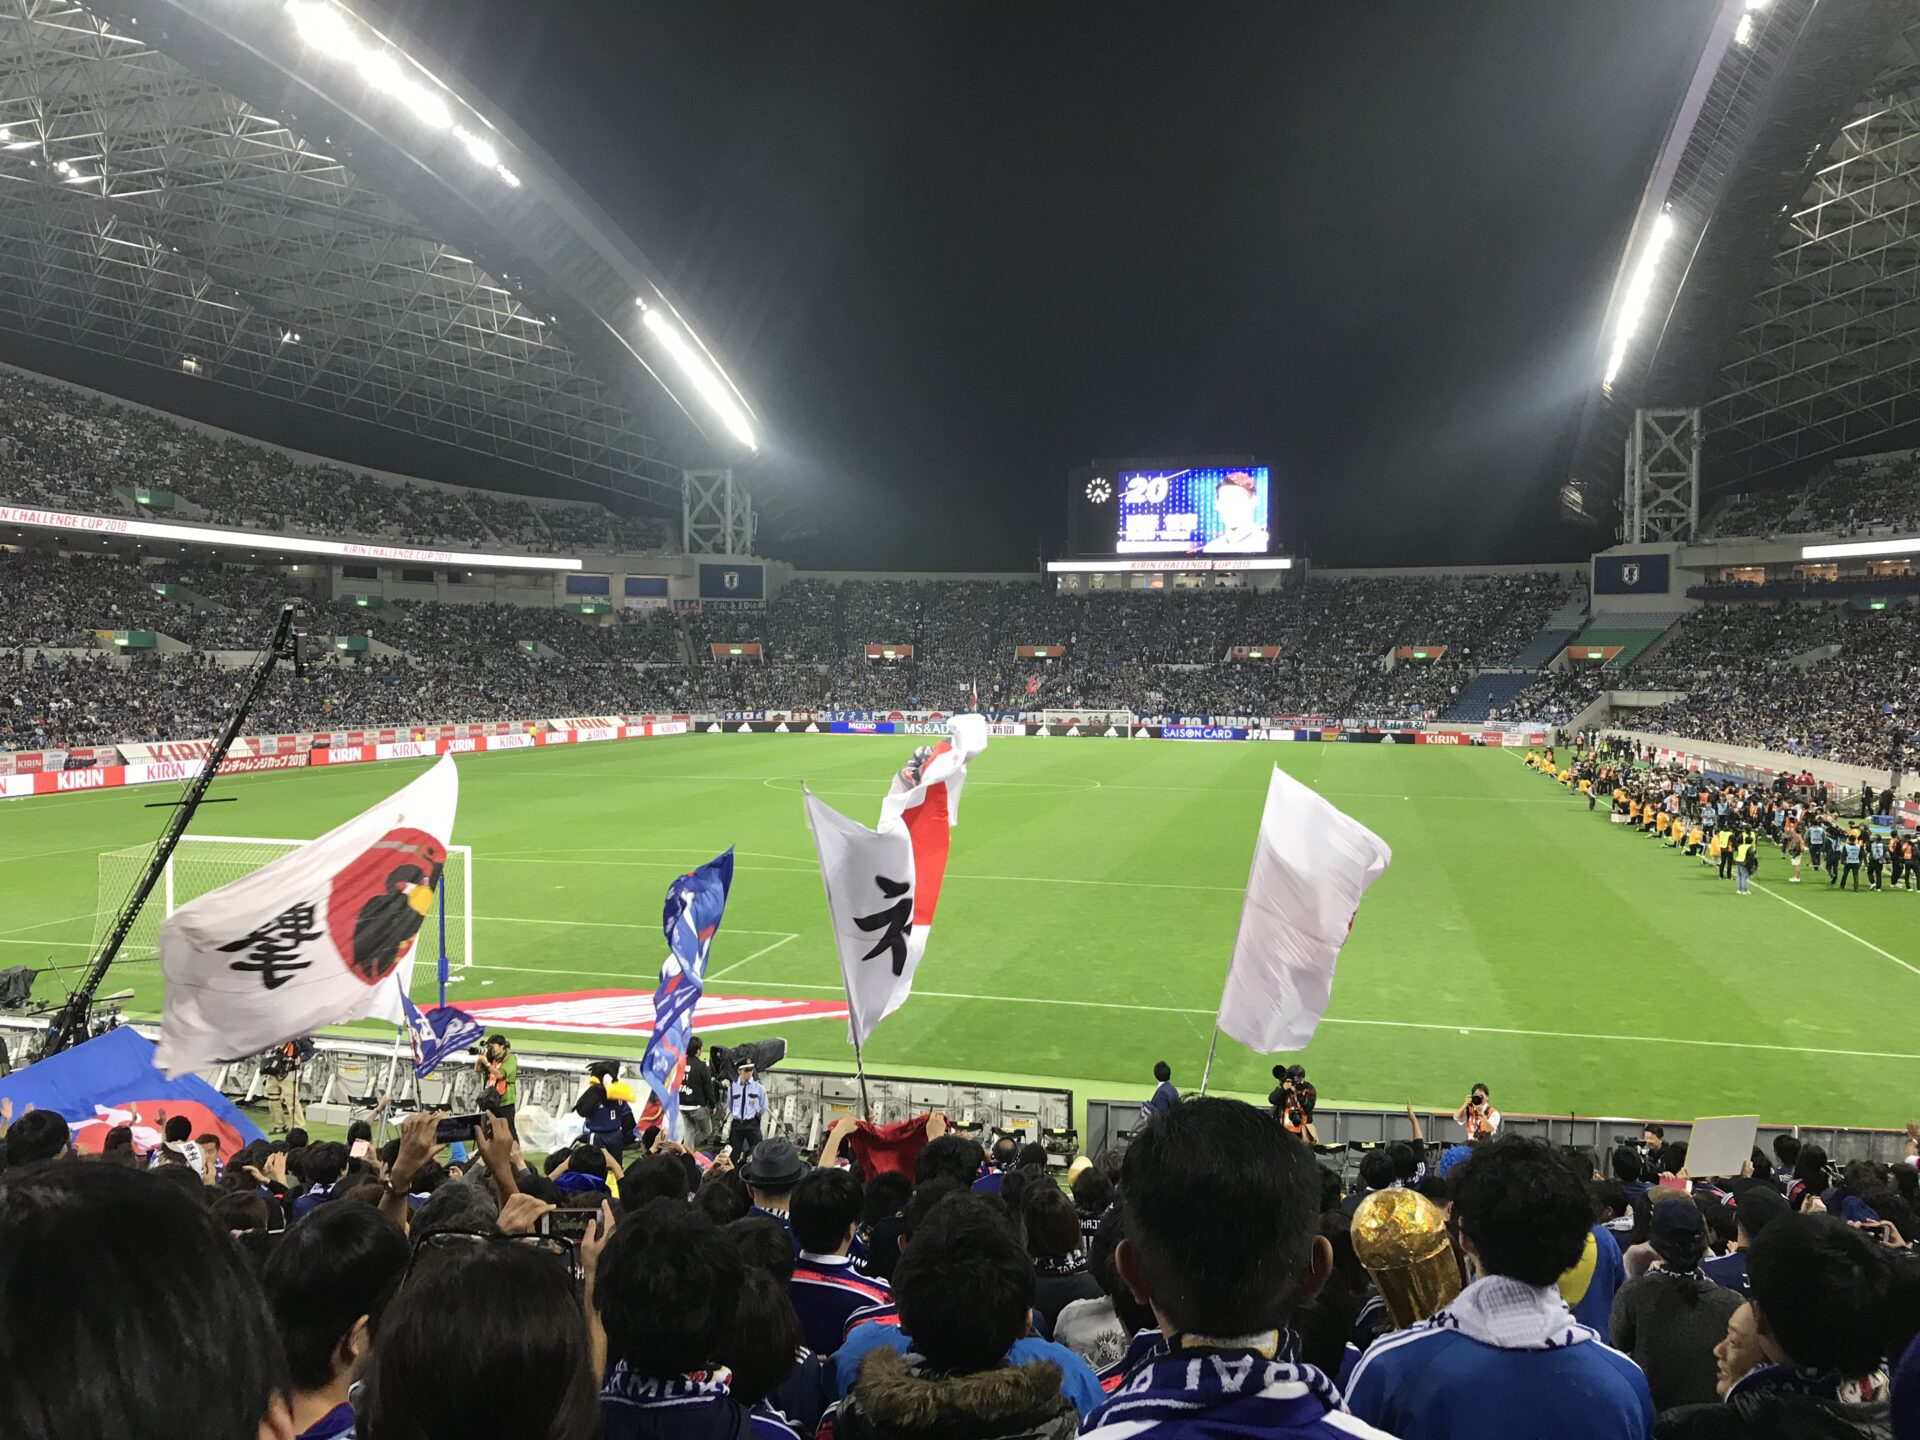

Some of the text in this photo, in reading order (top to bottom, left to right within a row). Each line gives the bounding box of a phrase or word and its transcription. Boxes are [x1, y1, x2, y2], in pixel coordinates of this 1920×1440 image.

[1124, 477, 1168, 503] 20
[12, 510, 78, 527] CHALLENGE
[81, 517, 103, 528] CUP
[105, 520, 127, 531] 2018
[343, 545, 452, 562] KIRIN CHALLENGE CUP 2018
[1158, 561, 1207, 569] CHALLENGE
[1212, 561, 1230, 569] CUP
[1232, 560, 1250, 569] 2018
[904, 723, 949, 734] MS&AD
[1163, 729, 1232, 739] SAISON CARD
[1246, 730, 1268, 740] JFA
[448, 738, 475, 752] KIRIN
[500, 735, 523, 747] KIRIN
[1426, 735, 1458, 744] KIRIN
[329, 747, 361, 763] KIRIN
[392, 743, 421, 757] KIRIN
[18, 759, 41, 769] KIRIN
[288, 754, 307, 767] 2018
[147, 762, 186, 780] KIRIN
[57, 768, 104, 790] KIRIN
